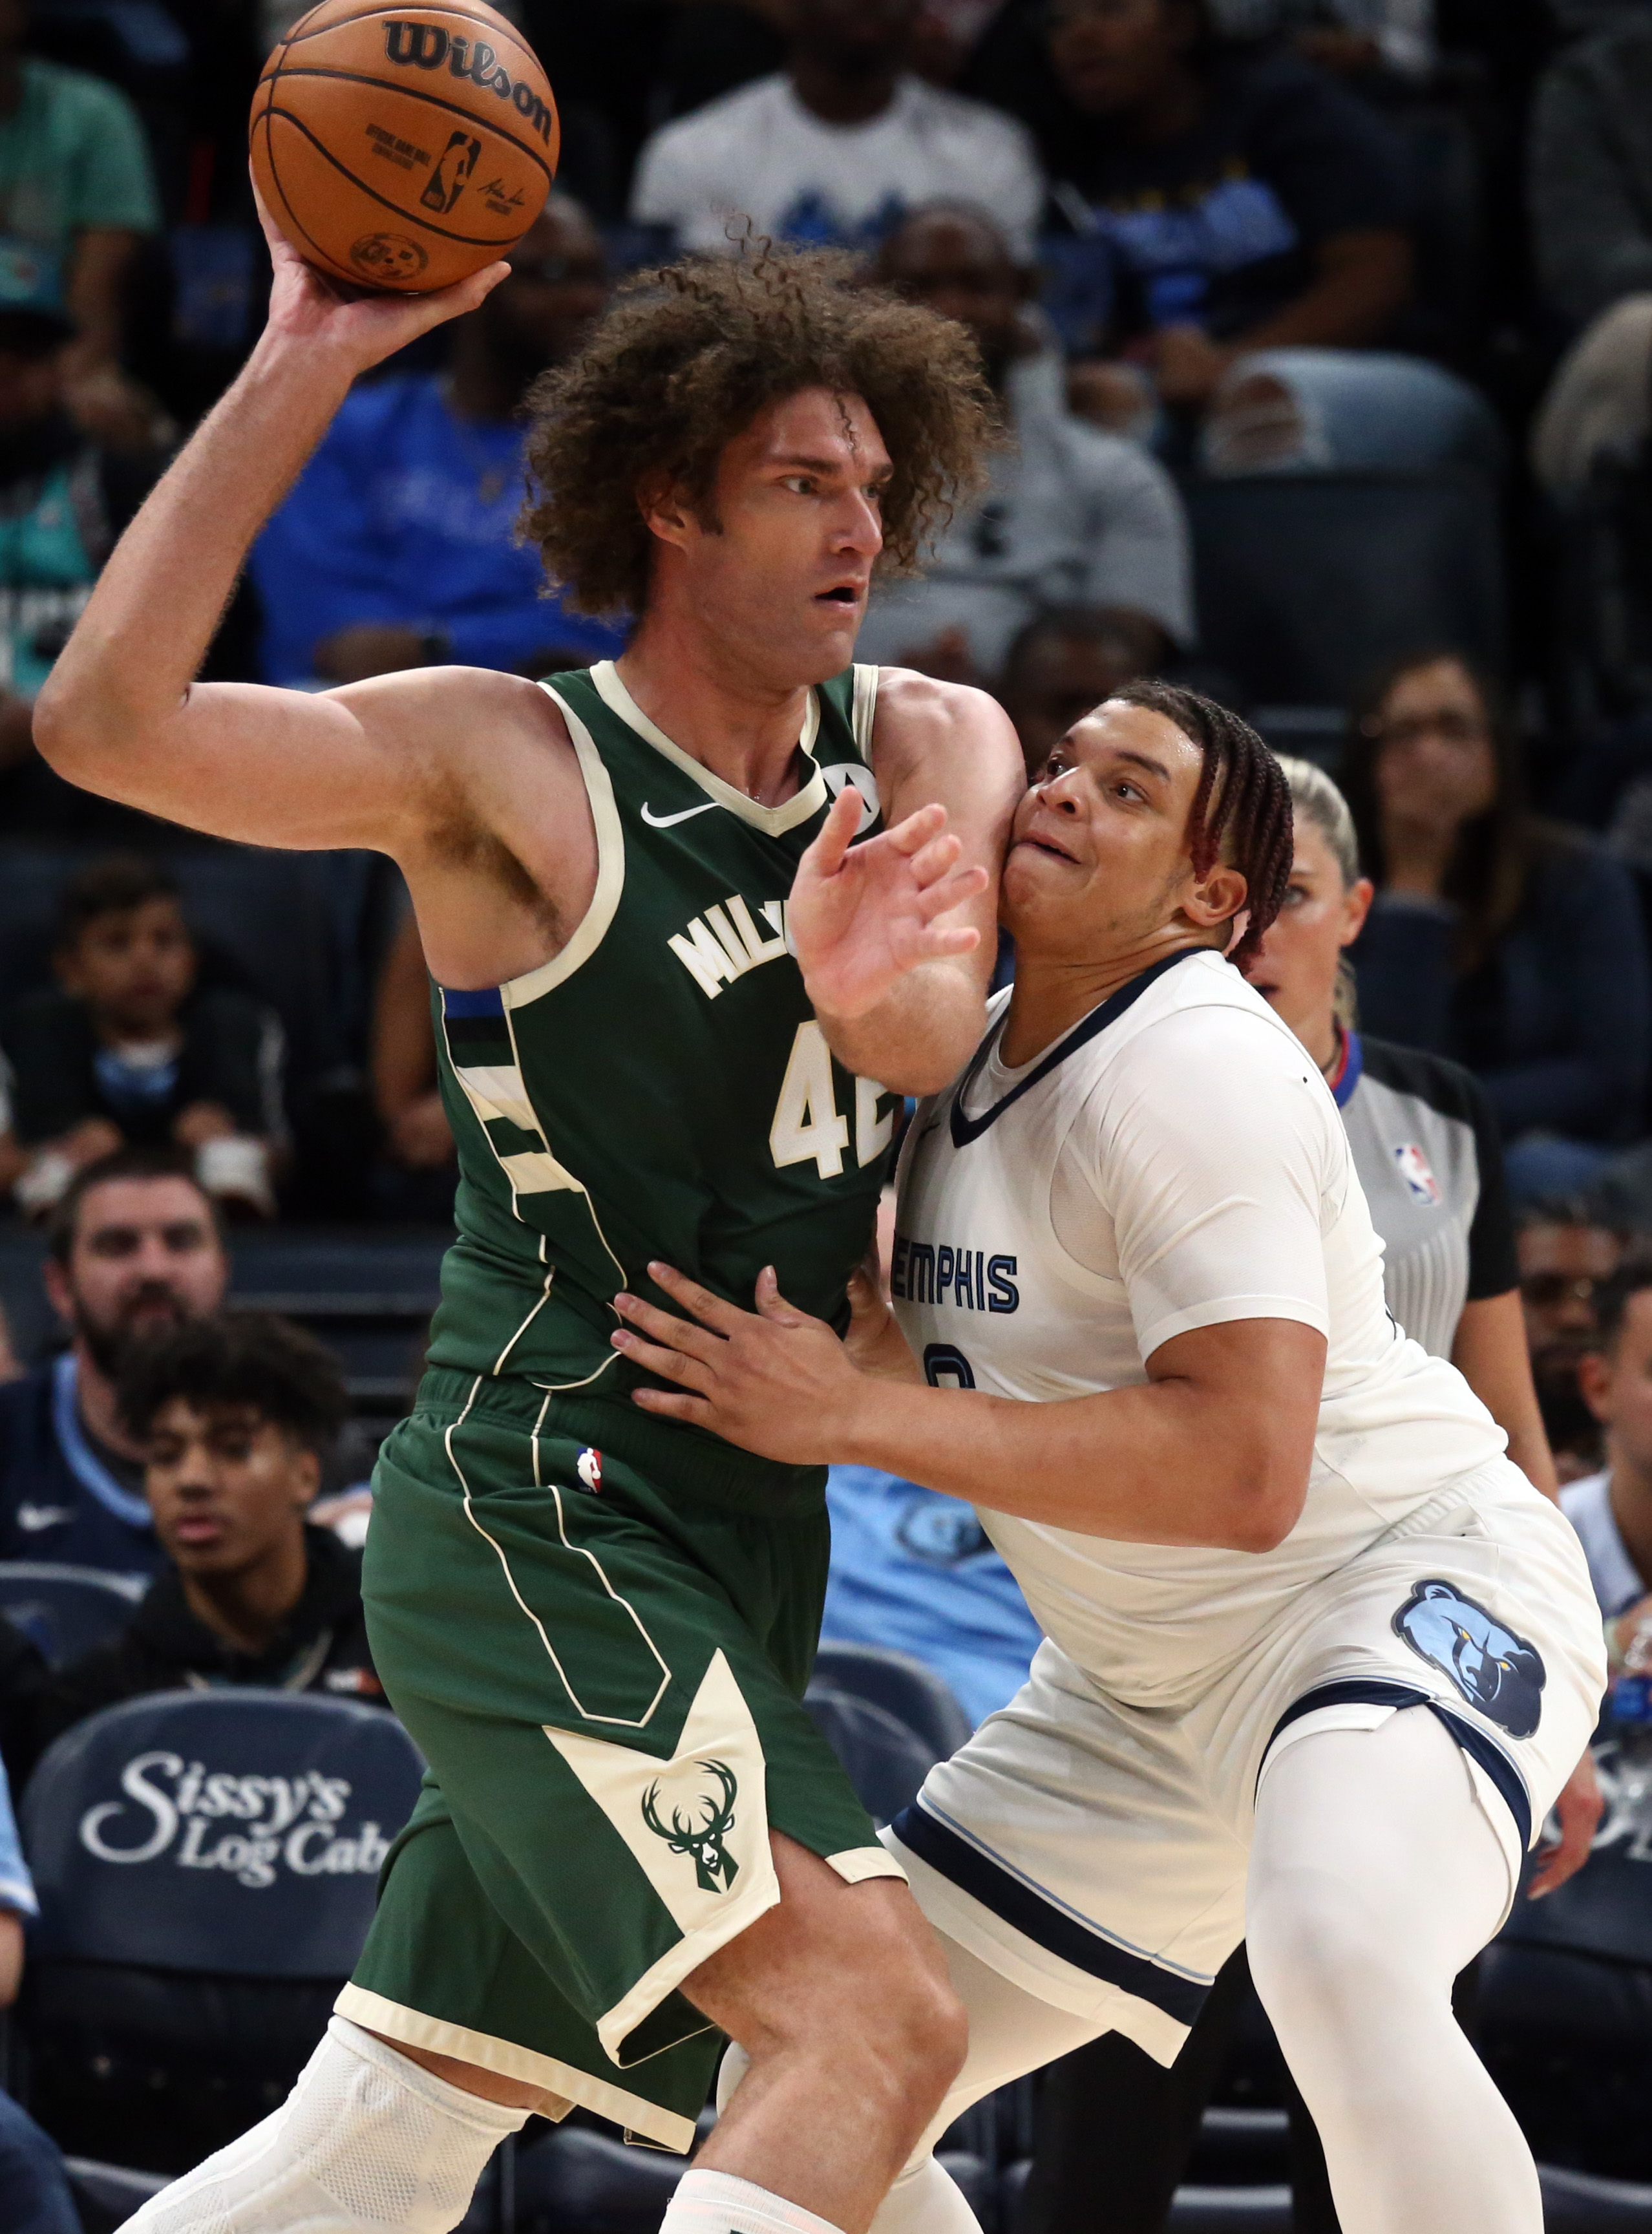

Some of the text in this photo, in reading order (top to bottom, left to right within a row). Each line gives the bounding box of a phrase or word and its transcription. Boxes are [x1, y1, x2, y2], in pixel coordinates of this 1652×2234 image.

[382, 20, 552, 147] Wilson
[666, 894, 800, 999] MIL
[890, 1235, 1020, 1314] EMPHIS
[79, 1750, 352, 1863] Sissy's
[176, 1816, 394, 1888] Log Cab
